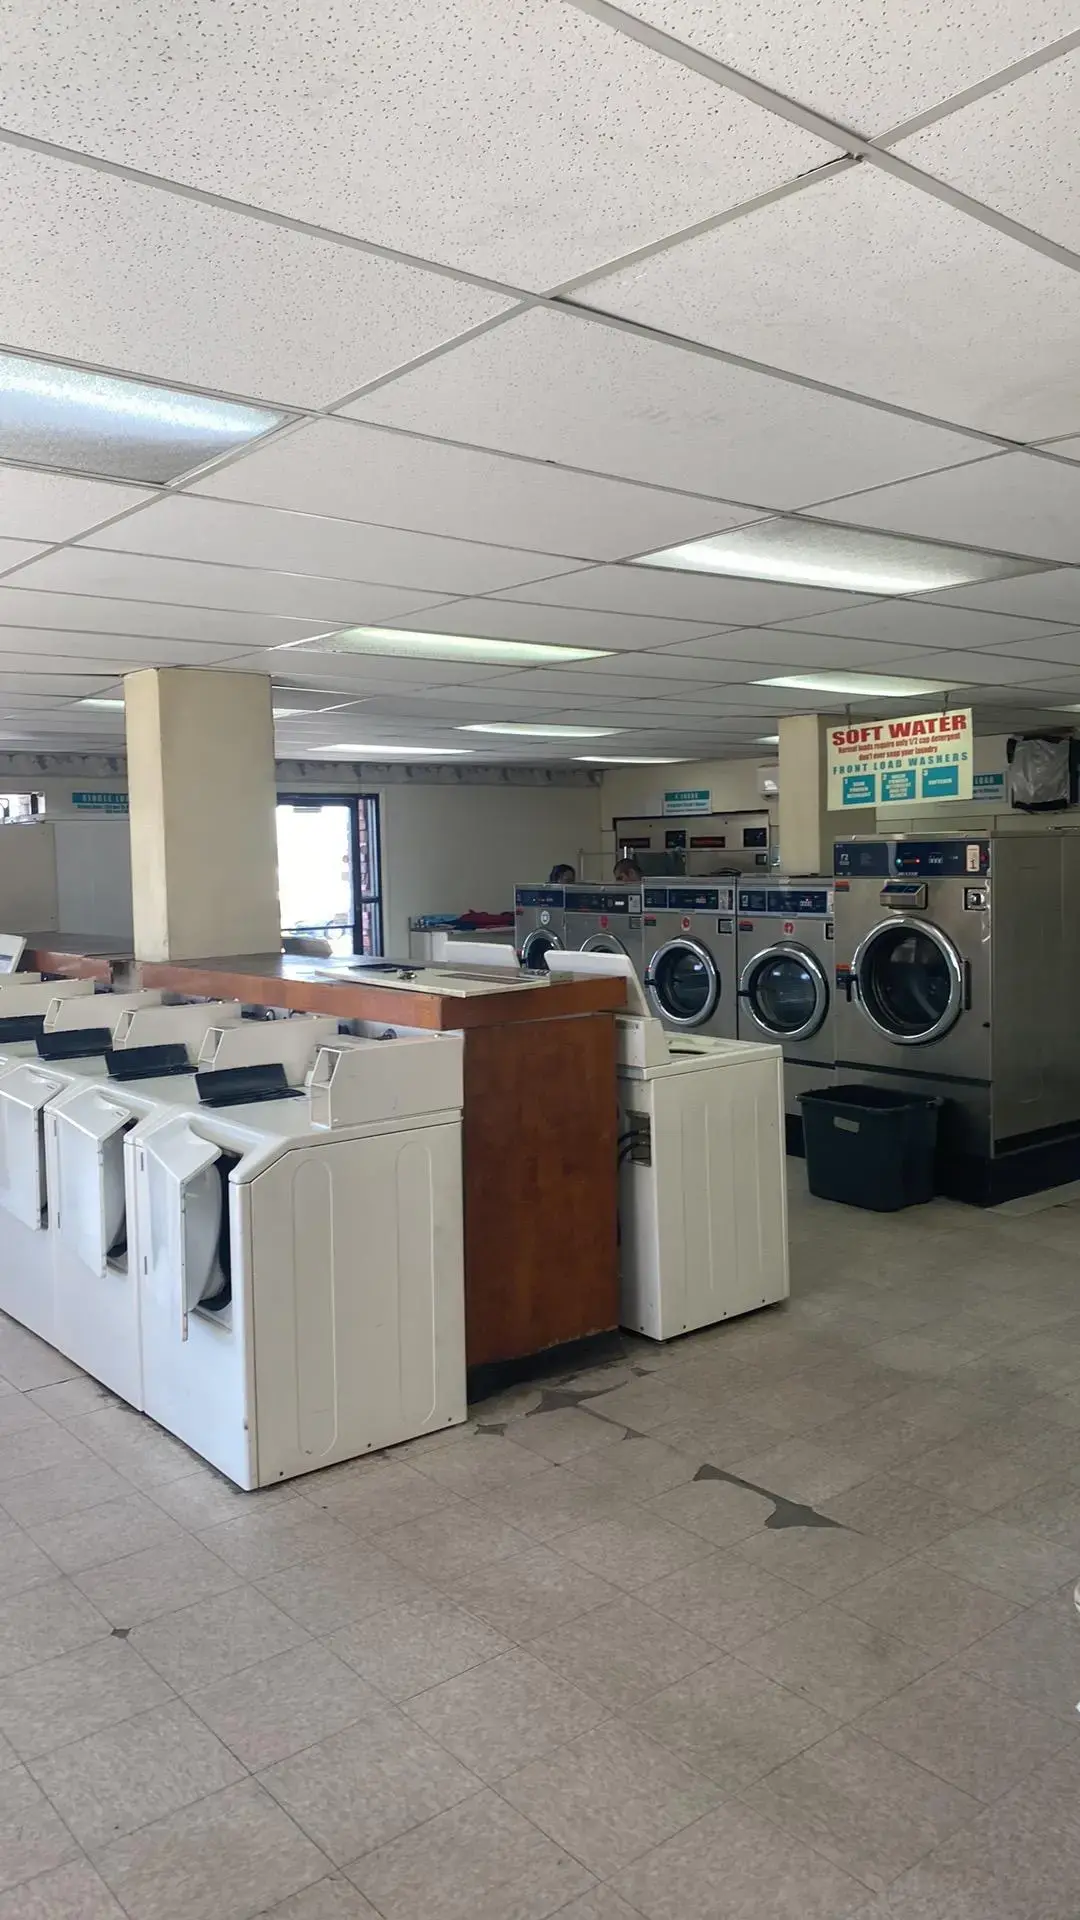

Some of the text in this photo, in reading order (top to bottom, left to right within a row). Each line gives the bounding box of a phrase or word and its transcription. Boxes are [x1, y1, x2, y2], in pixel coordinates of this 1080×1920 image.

[832, 714, 967, 746] SOFT WATER
[838, 745, 857, 754] Normal
[873, 741, 895, 751] require
[895, 739, 908, 748] only
[909, 737, 918, 745] 1/2
[918, 736, 930, 745] cup
[931, 732, 961, 743] detergent
[901, 748, 914, 757] your
[915, 745, 938, 755] laundry
[832, 751, 968, 775] FRONT LOAD WASHERS
